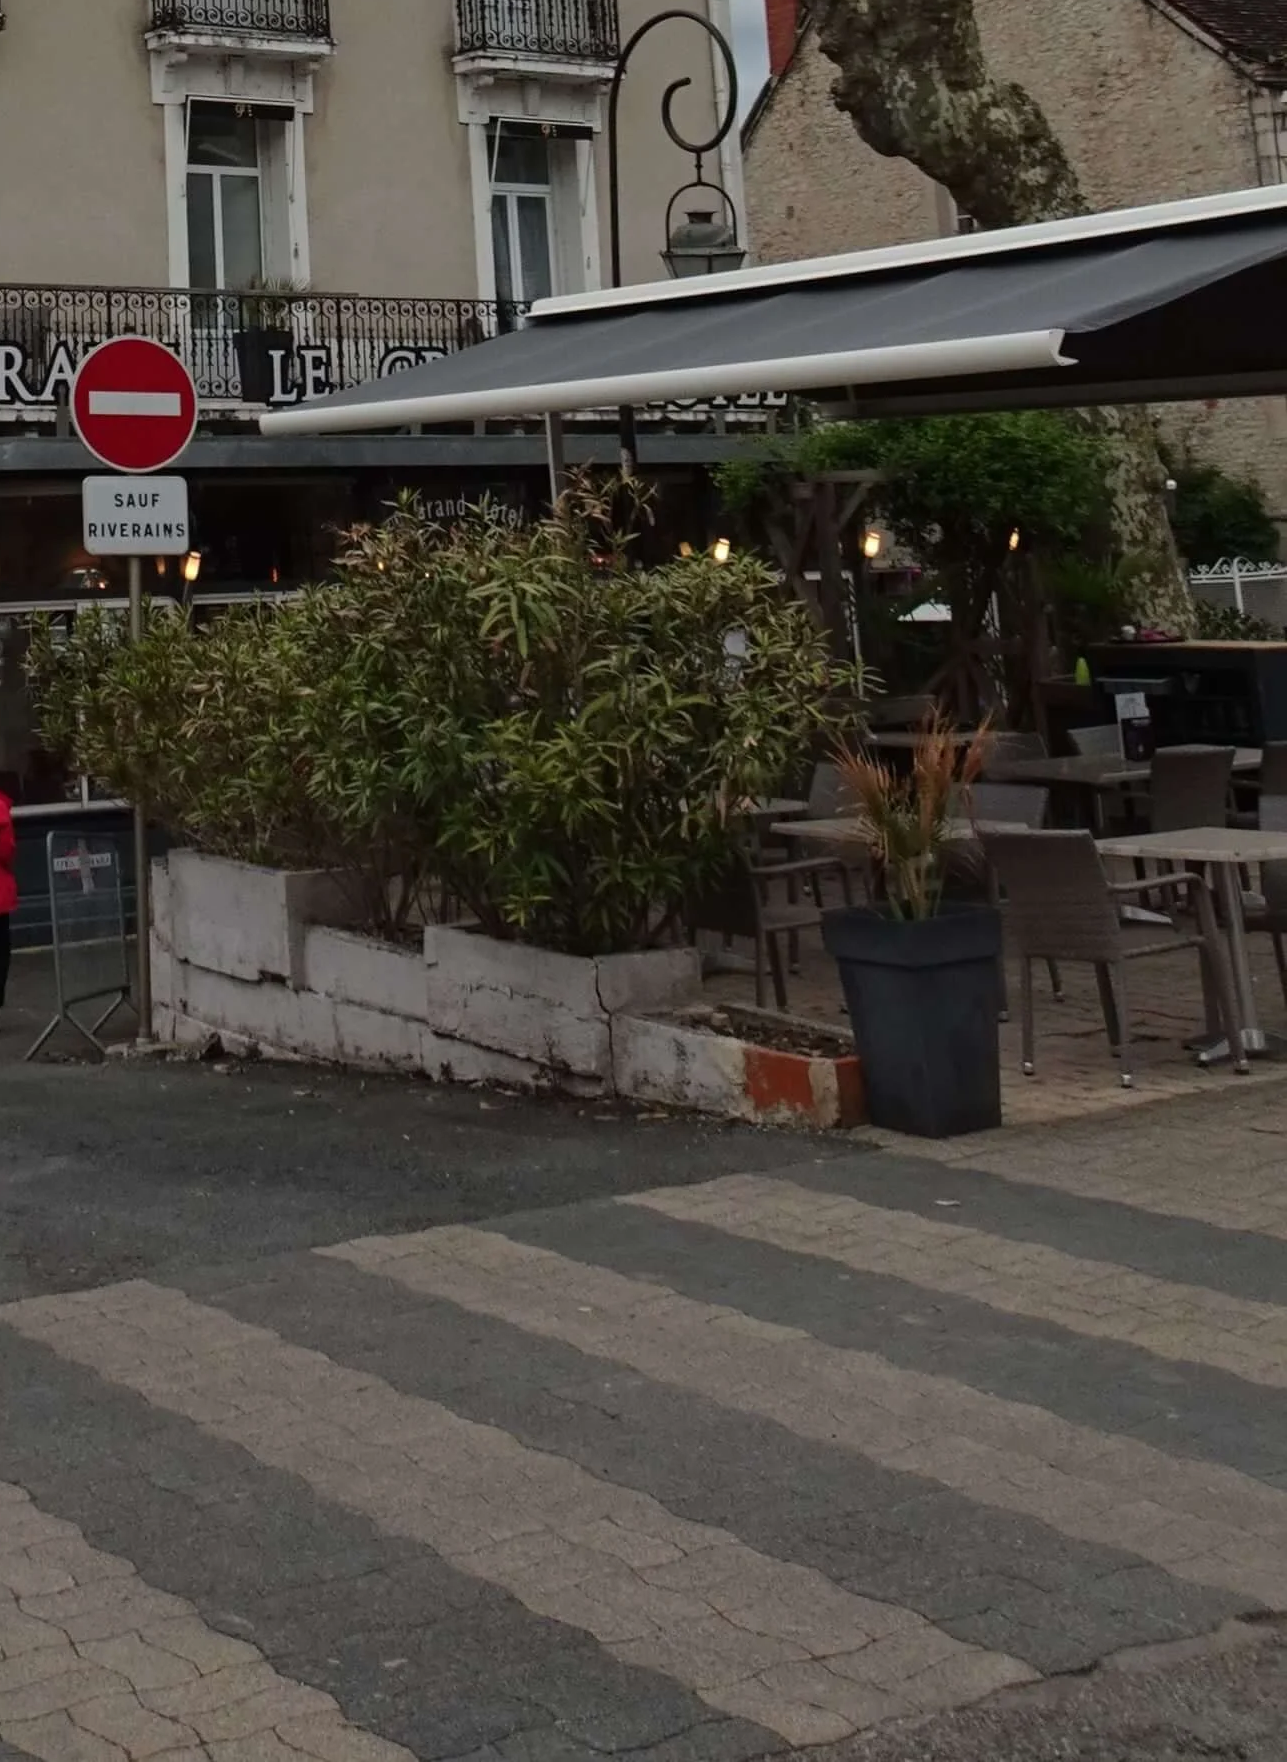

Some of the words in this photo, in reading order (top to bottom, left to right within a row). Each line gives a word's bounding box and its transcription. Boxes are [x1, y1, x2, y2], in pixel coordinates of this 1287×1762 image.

[267, 349, 330, 402] LE
[113, 493, 161, 508] SAUF
[88, 522, 186, 538] RIVERAINS
